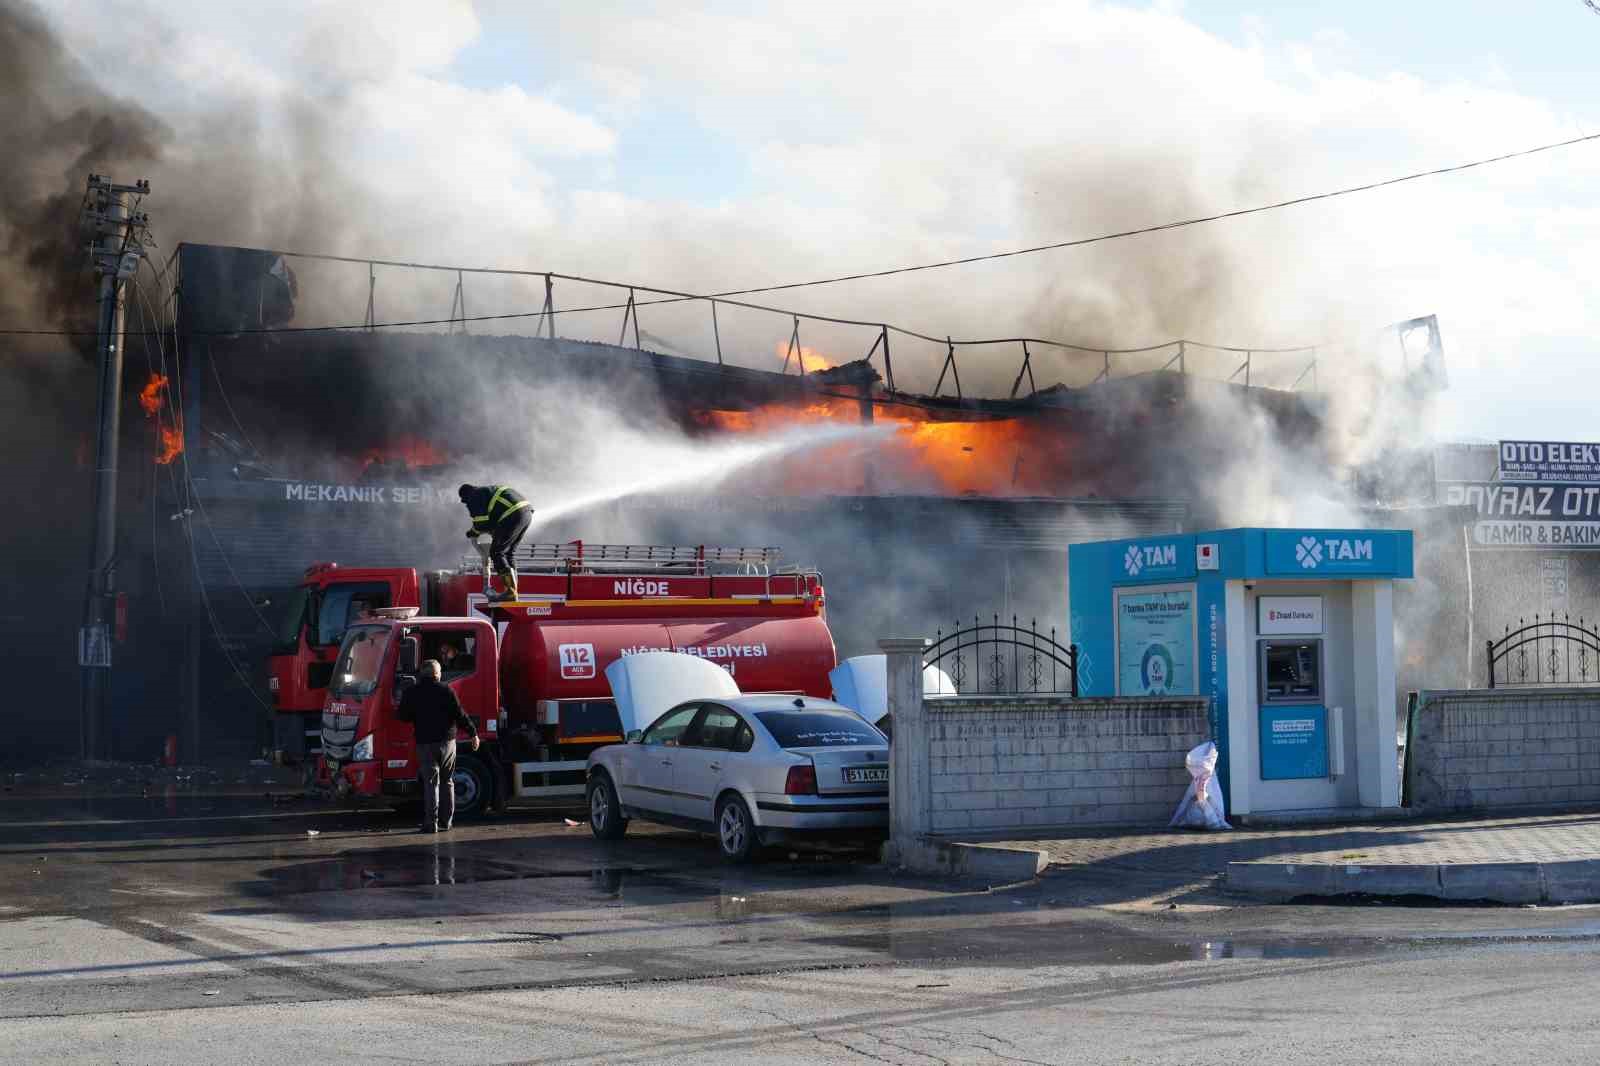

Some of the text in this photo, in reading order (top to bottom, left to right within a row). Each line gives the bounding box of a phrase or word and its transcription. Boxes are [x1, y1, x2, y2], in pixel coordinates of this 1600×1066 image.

[1503, 443, 1543, 462] OTO
[286, 483, 384, 502] MEKANİK
[1537, 525, 1548, 543] &
[1144, 545, 1176, 565] TAM
[1325, 540, 1372, 559] TAM
[614, 578, 669, 595] NİĞDE
[565, 648, 589, 663] 112
